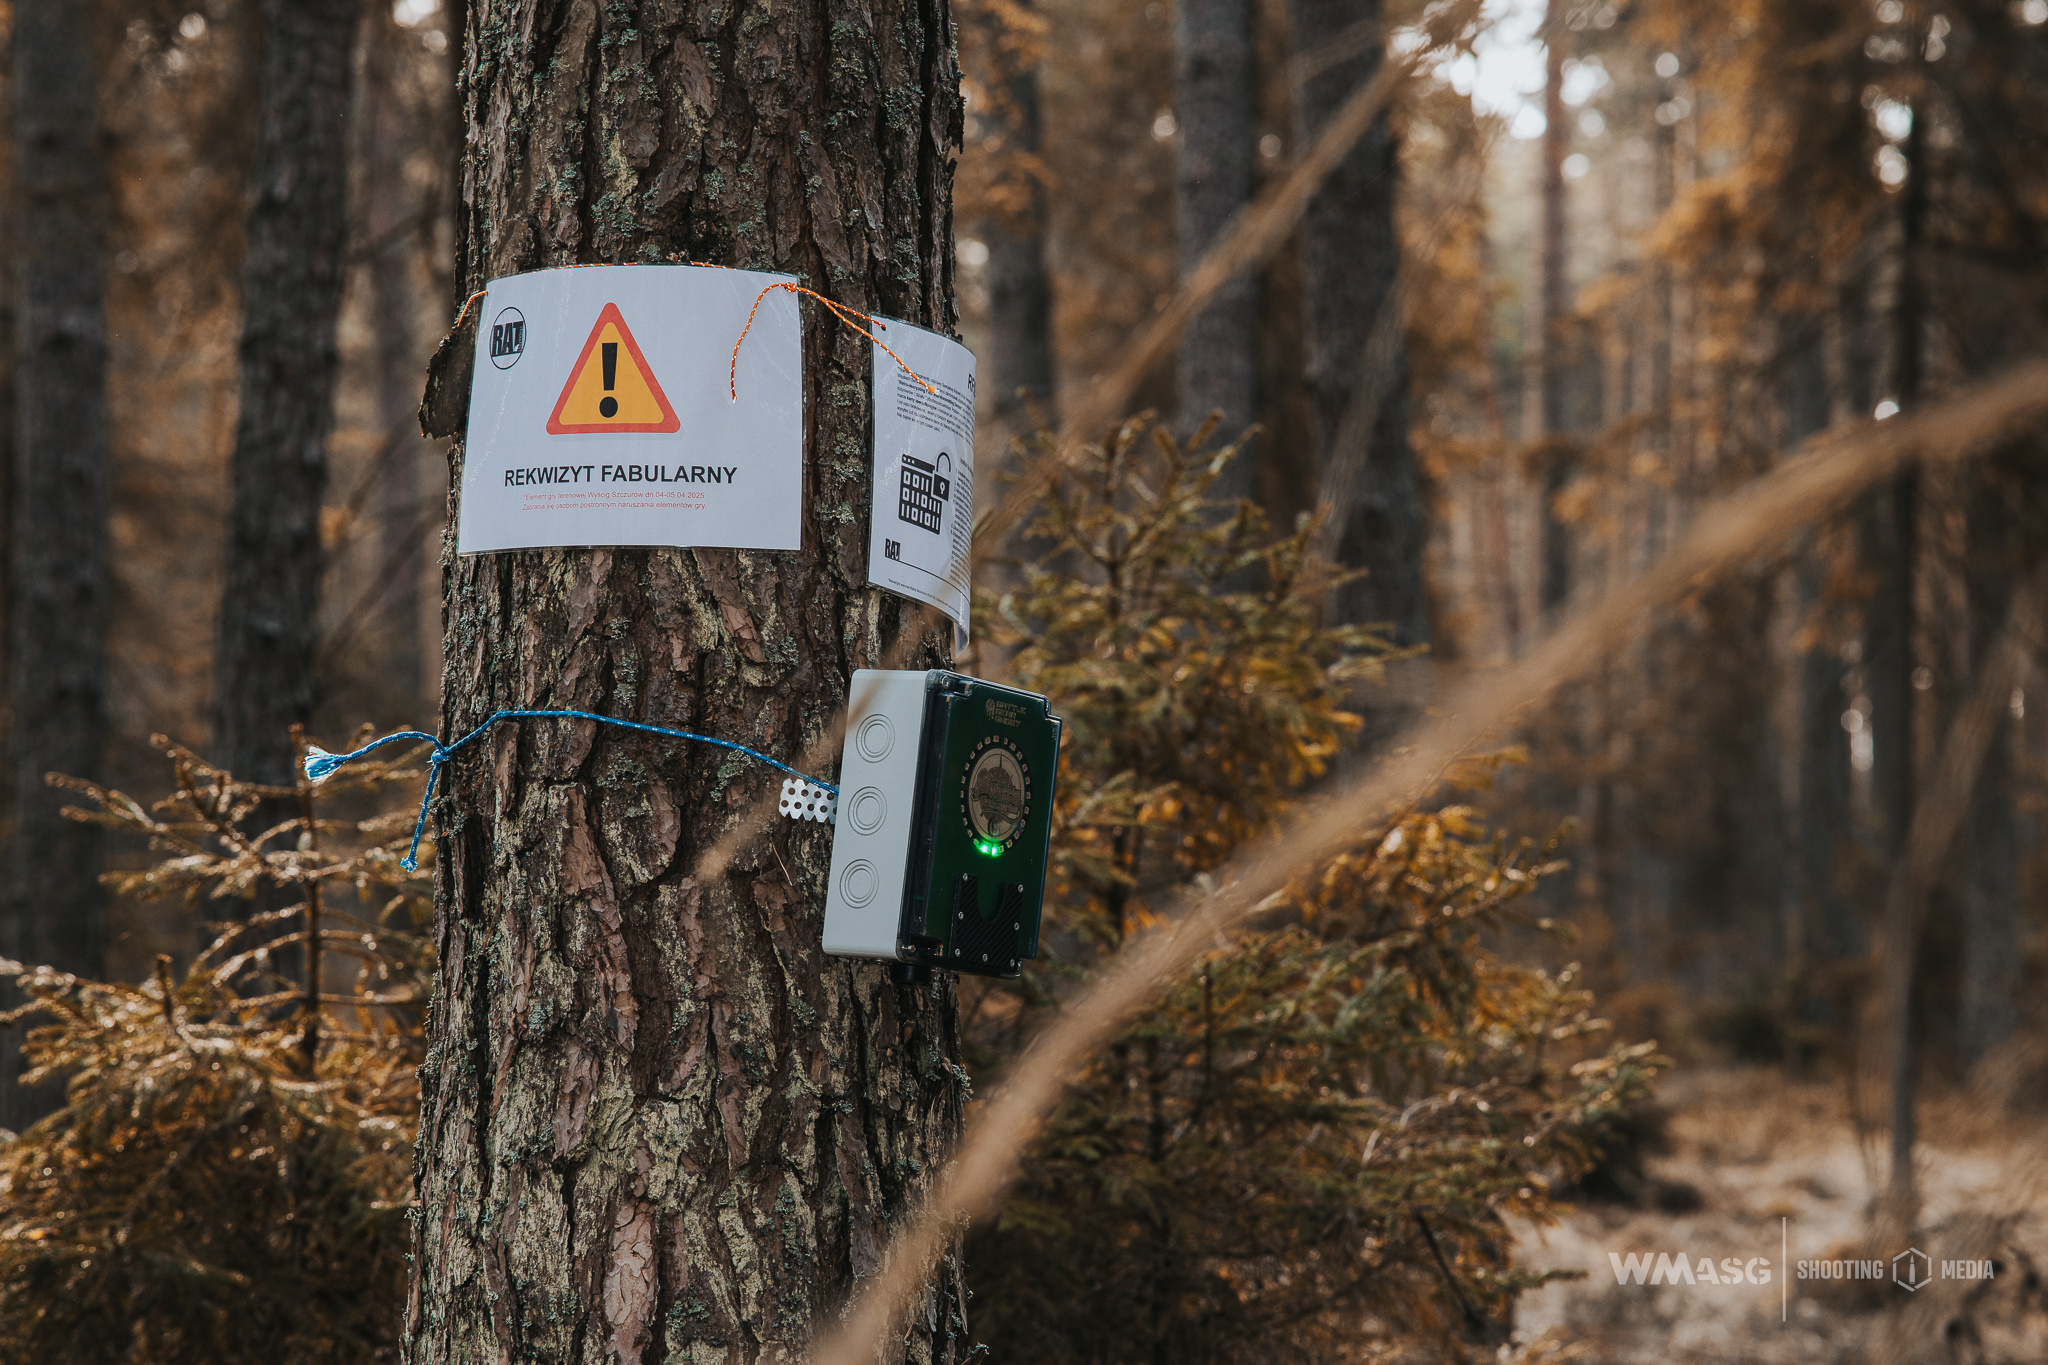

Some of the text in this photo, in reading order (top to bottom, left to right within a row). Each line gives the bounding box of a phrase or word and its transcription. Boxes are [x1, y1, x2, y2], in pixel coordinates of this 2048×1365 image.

[492, 321, 523, 356] RAT
[504, 465, 738, 487] REKWIZYT FABULARNY
[547, 494, 557, 502] gry
[558, 492, 586, 500] terenowej
[587, 491, 610, 500] Wyścig
[611, 490, 643, 498] Szczurów
[522, 503, 546, 511] Zabrania
[546, 502, 555, 510] się
[580, 501, 616, 509] postronnym
[656, 501, 692, 509] elementów
[695, 502, 707, 511] gry.
[996, 700, 1026, 714] BATTLE
[995, 708, 1017, 719] GEAR
[994, 715, 1021, 727] GHOST
